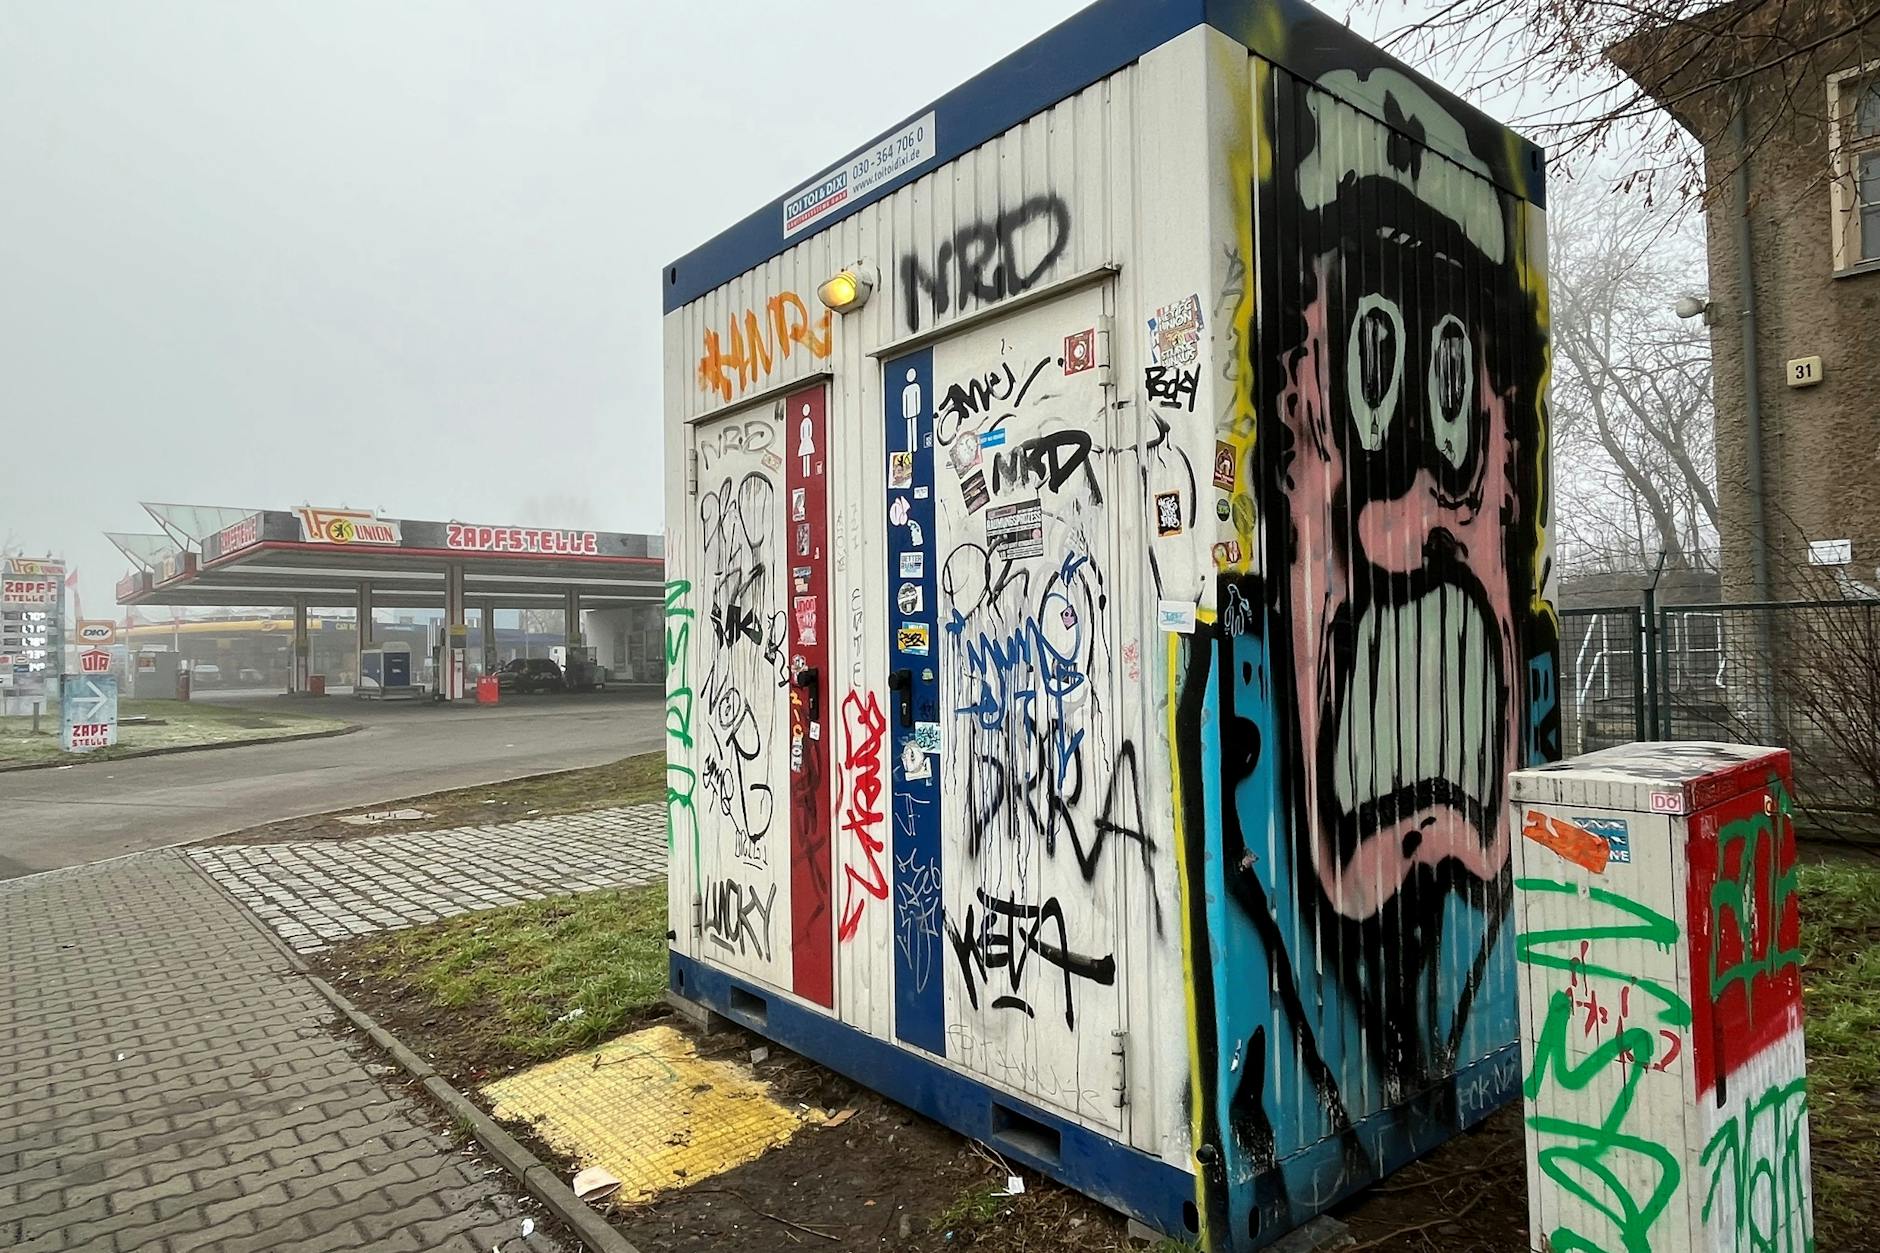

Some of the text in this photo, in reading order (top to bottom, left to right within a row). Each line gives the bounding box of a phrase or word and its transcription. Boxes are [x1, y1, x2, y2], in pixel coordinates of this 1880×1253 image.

[852, 158, 870, 180] 030
[876, 144, 894, 167] 364
[896, 131, 915, 154] 706
[917, 126, 924, 143] 0
[788, 173, 847, 218] TOI TOI & DIXI
[1795, 363, 1812, 379] 31
[354, 525, 395, 542] UNION
[447, 525, 598, 554] ZAPFSTELLE
[5, 582, 45, 593] ZAPF
[4, 594, 45, 602] STELLE
[83, 628, 109, 638] DKV
[82, 650, 110, 671] UTA
[73, 724, 108, 737] ZAPF
[72, 738, 108, 748] STELLE
